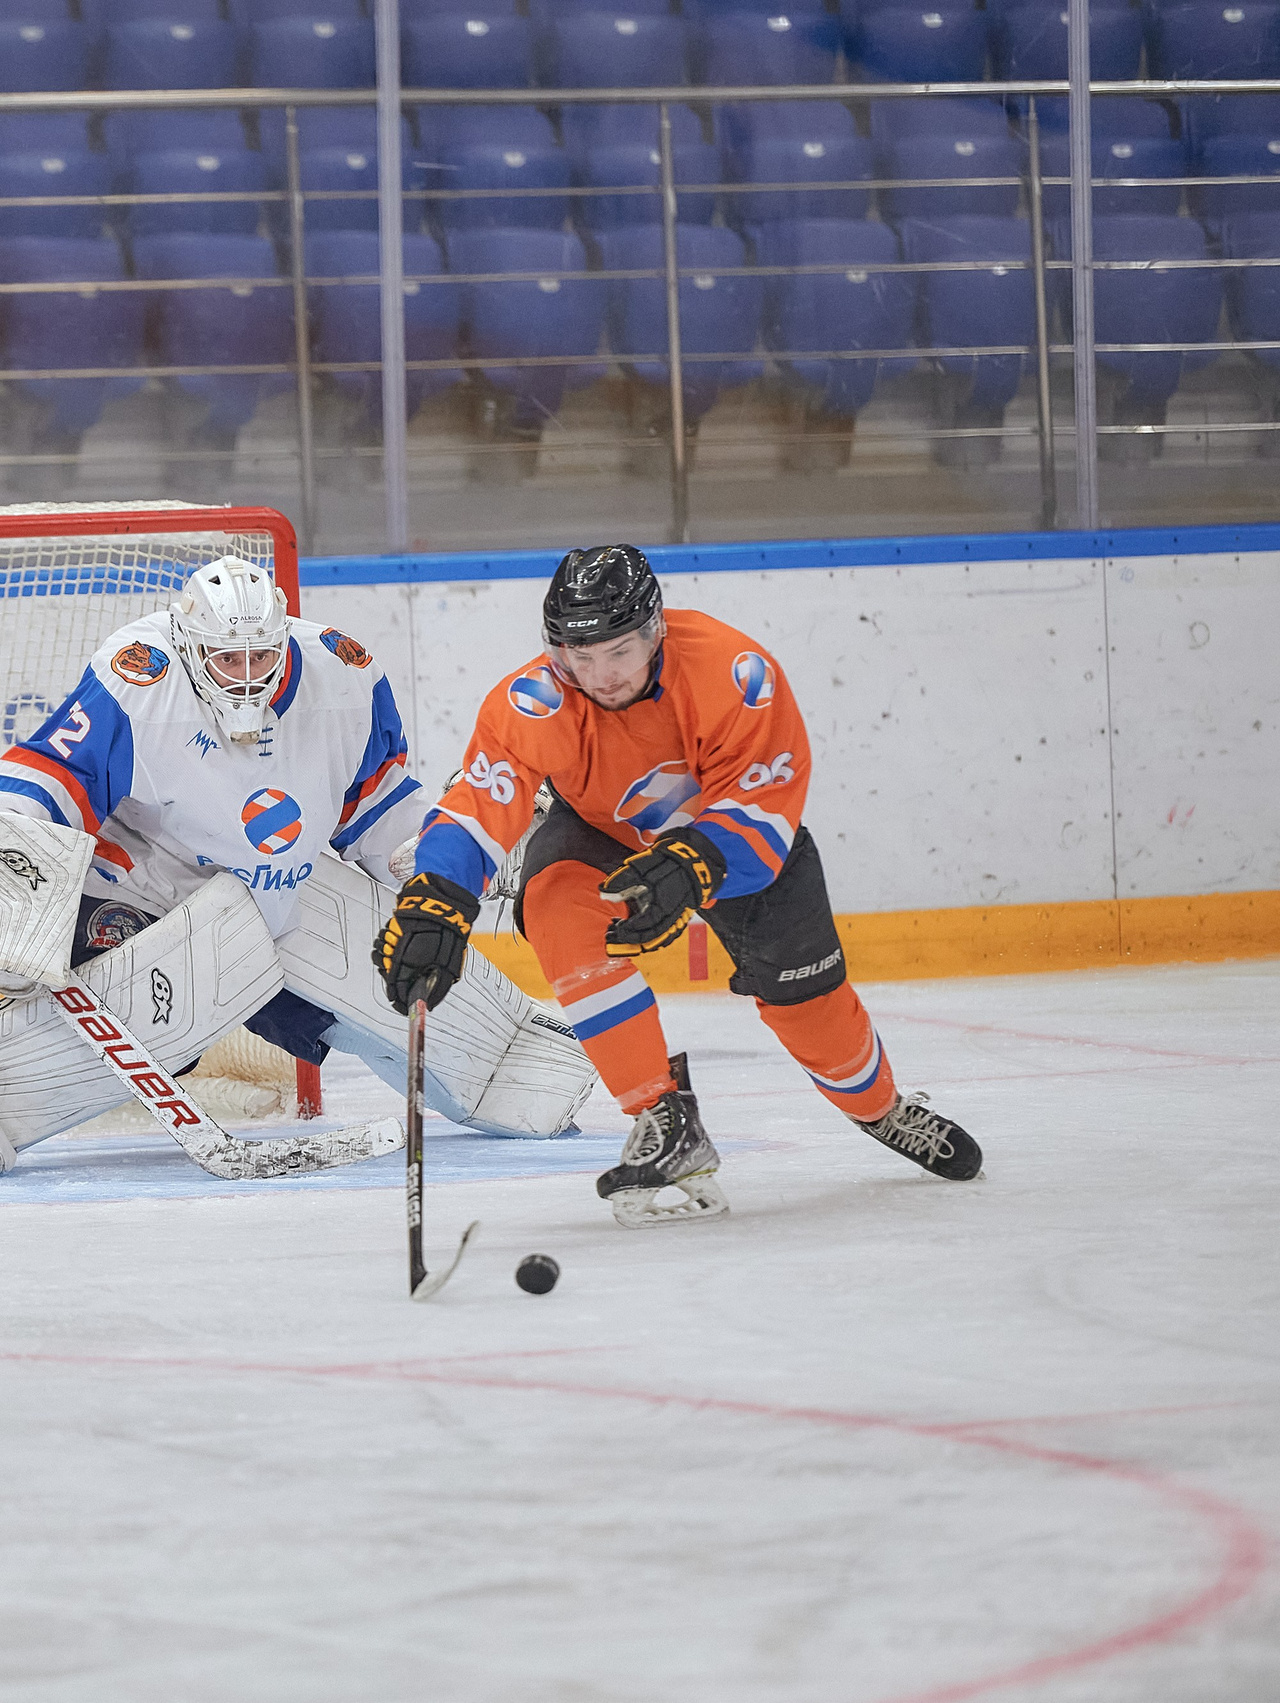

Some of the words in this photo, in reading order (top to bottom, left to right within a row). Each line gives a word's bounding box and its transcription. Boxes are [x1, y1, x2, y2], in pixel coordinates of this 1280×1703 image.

[567, 618, 599, 628] CCM
[465, 750, 518, 805] 96
[398, 896, 471, 935] CCM
